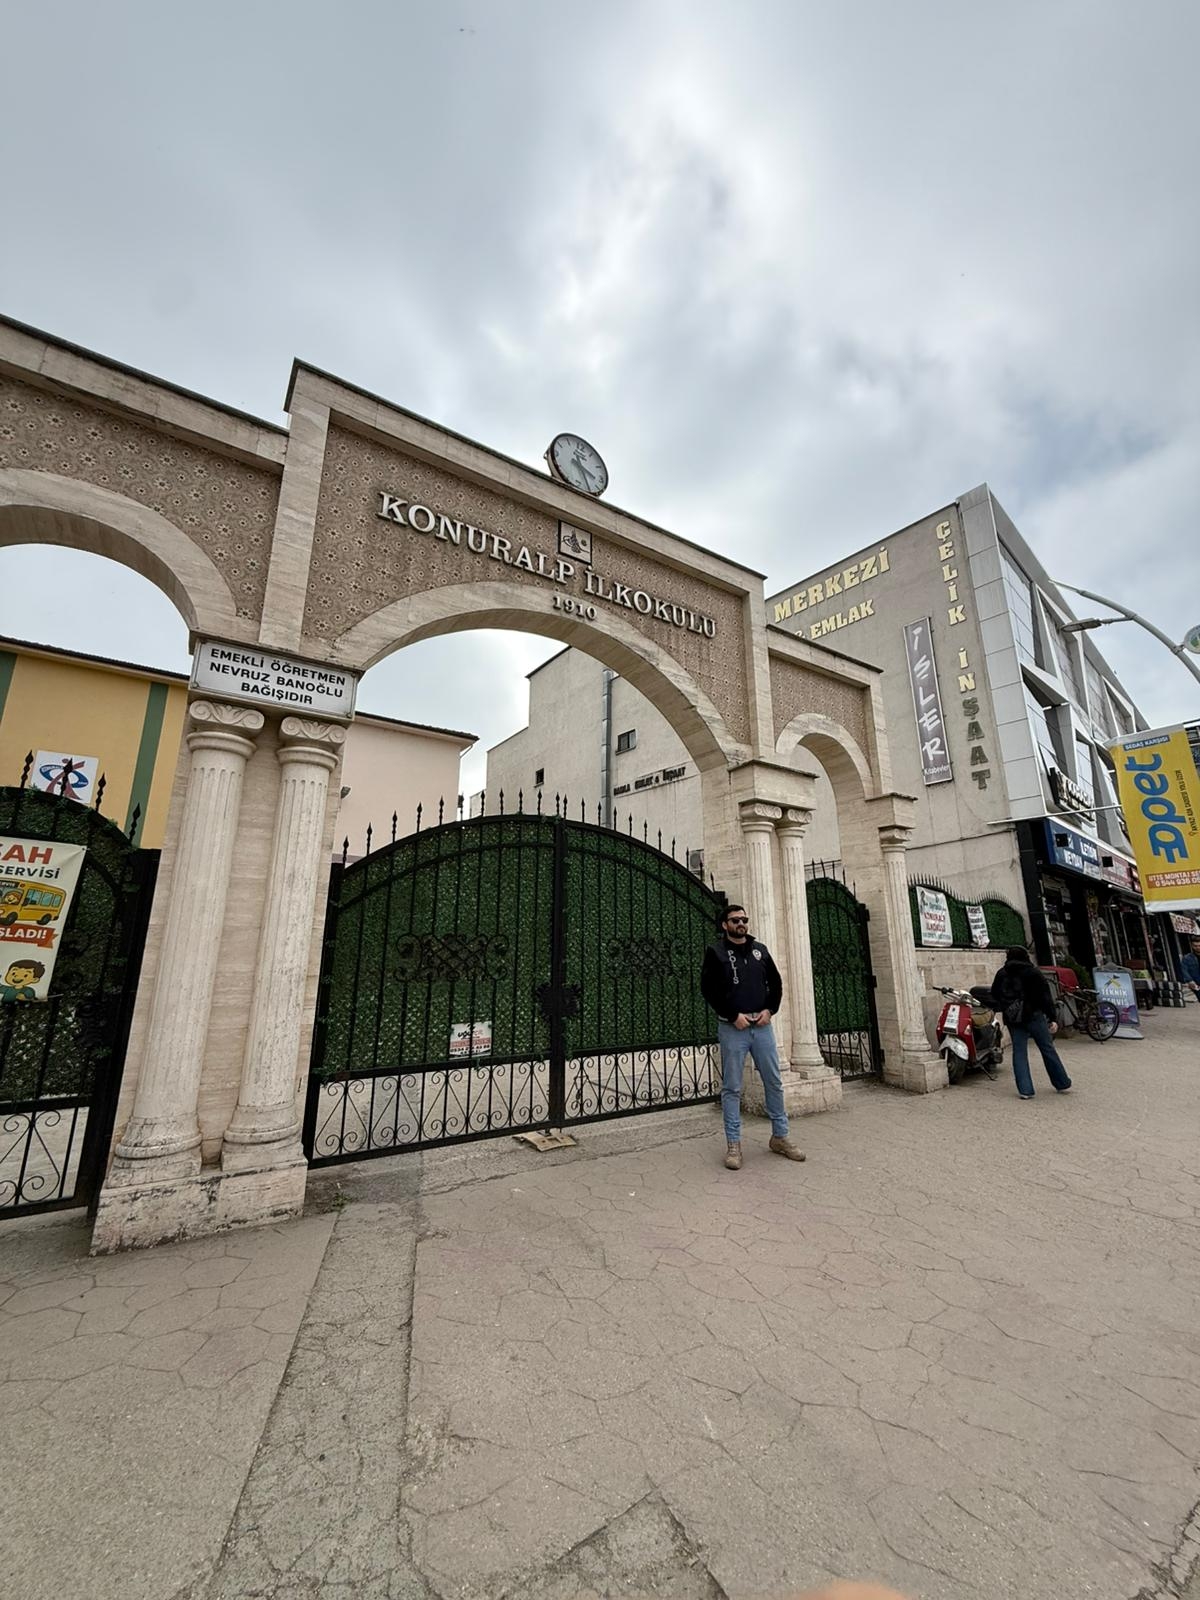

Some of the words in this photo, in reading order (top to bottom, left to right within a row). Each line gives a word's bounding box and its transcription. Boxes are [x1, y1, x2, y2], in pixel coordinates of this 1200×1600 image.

[376, 491, 575, 585] KONURALP
[583, 565, 717, 639] İLKOKULU
[774, 546, 890, 624] MERKEZİ
[553, 596, 598, 621] 1910
[810, 599, 875, 640] EMLAK
[210, 648, 265, 669] EMEKLİ
[270, 660, 346, 686] ÖĞRETMEN
[936, 521, 967, 626] ÇELİK
[958, 648, 991, 790] İNŞAAT
[209, 662, 271, 683] NEVRUZ
[276, 676, 343, 698] BANOĞLU
[241, 682, 313, 705] BAĞIŞIDIR
[0, 843, 54, 865] AH
